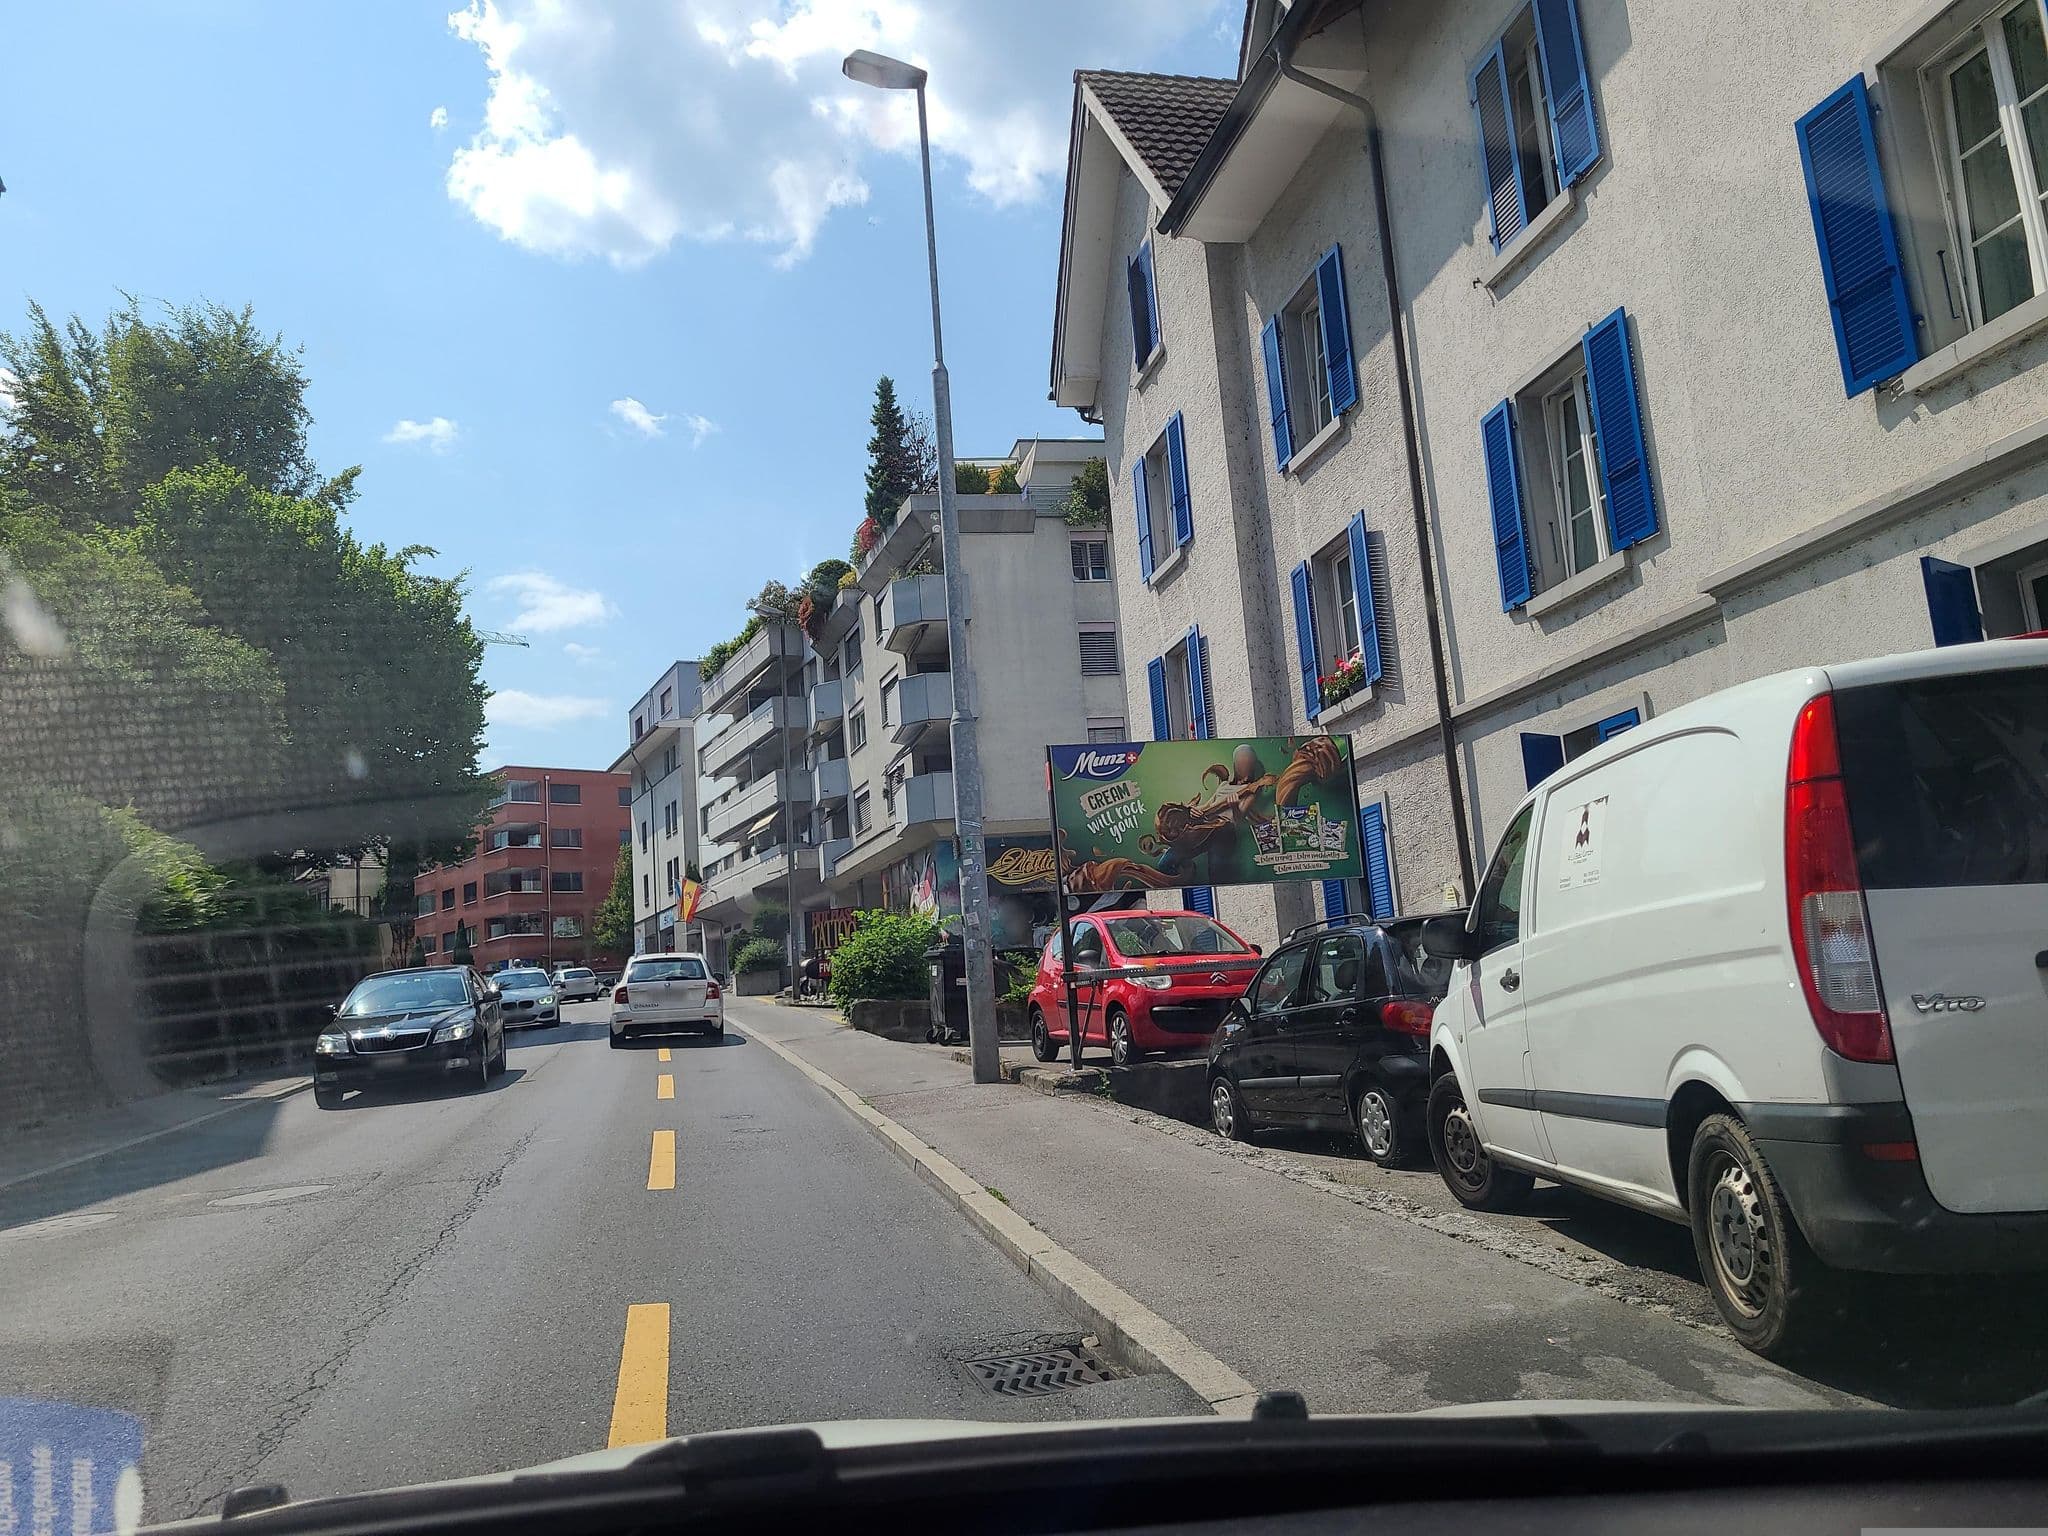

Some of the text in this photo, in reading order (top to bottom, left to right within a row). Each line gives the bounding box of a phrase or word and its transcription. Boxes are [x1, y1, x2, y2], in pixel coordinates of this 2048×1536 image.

[1061, 751, 1127, 780] Munz
[1087, 782, 1131, 811] CREAM
[1086, 799, 1147, 834] will rock
[1109, 815, 1139, 844] you!
